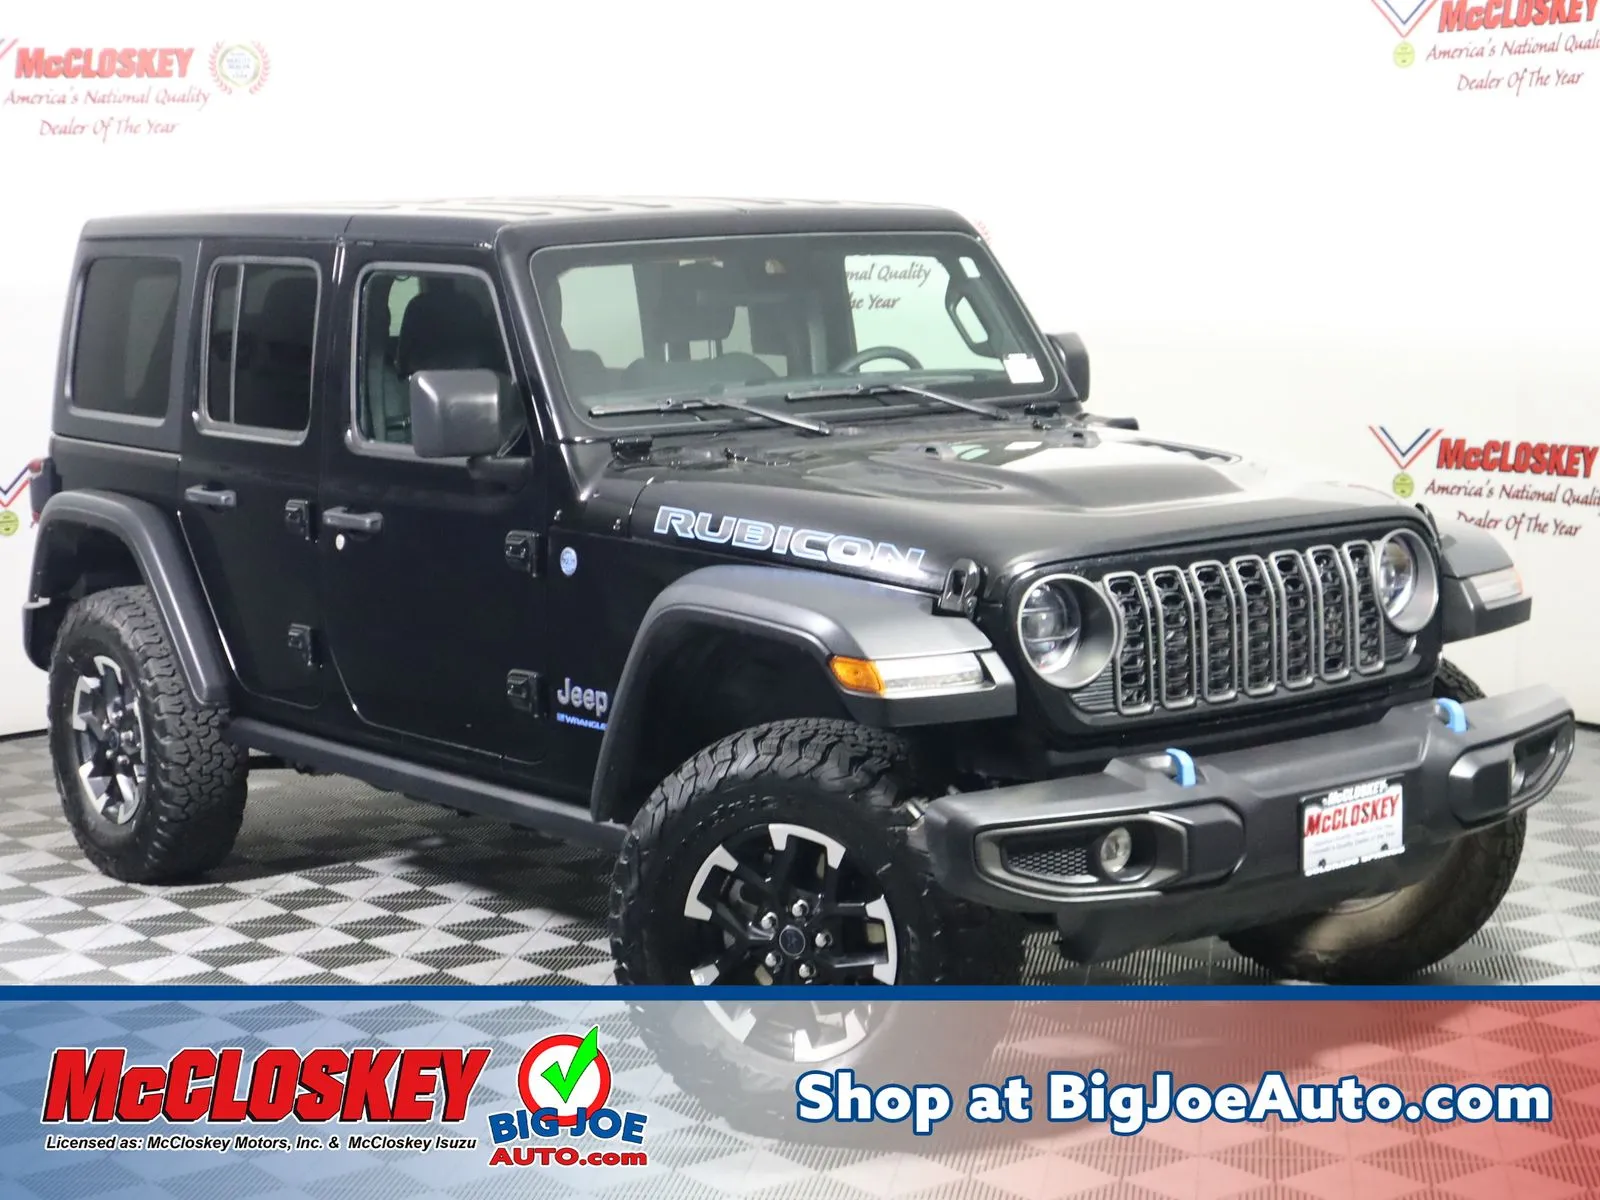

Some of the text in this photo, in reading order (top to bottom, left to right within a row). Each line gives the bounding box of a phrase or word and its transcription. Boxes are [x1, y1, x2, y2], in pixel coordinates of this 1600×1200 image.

[1438, 0, 1598, 33] McCLOSKEY
[1425, 38, 1496, 61] America's
[1500, 32, 1562, 56] National
[1564, 29, 1600, 54] Quali
[15, 47, 195, 79] McCLOSKEY
[1457, 66, 1584, 97] Dealer Of The Year
[4, 85, 211, 111] America's National Quality
[39, 116, 180, 143] Dealer Of The Year
[878, 261, 932, 288] Quality
[849, 291, 901, 310] he Year
[1436, 438, 1599, 479] McCLOSKEY
[1424, 478, 1495, 499] America's
[1498, 482, 1560, 504] National
[1562, 486, 1600, 508] Quali
[653, 505, 924, 576] RUBICON
[1505, 512, 1526, 541] Of
[1526, 513, 1549, 534] The
[1551, 517, 1582, 537] Year
[557, 677, 608, 717] Jeep
[1304, 793, 1400, 838] McCLOSKEY
